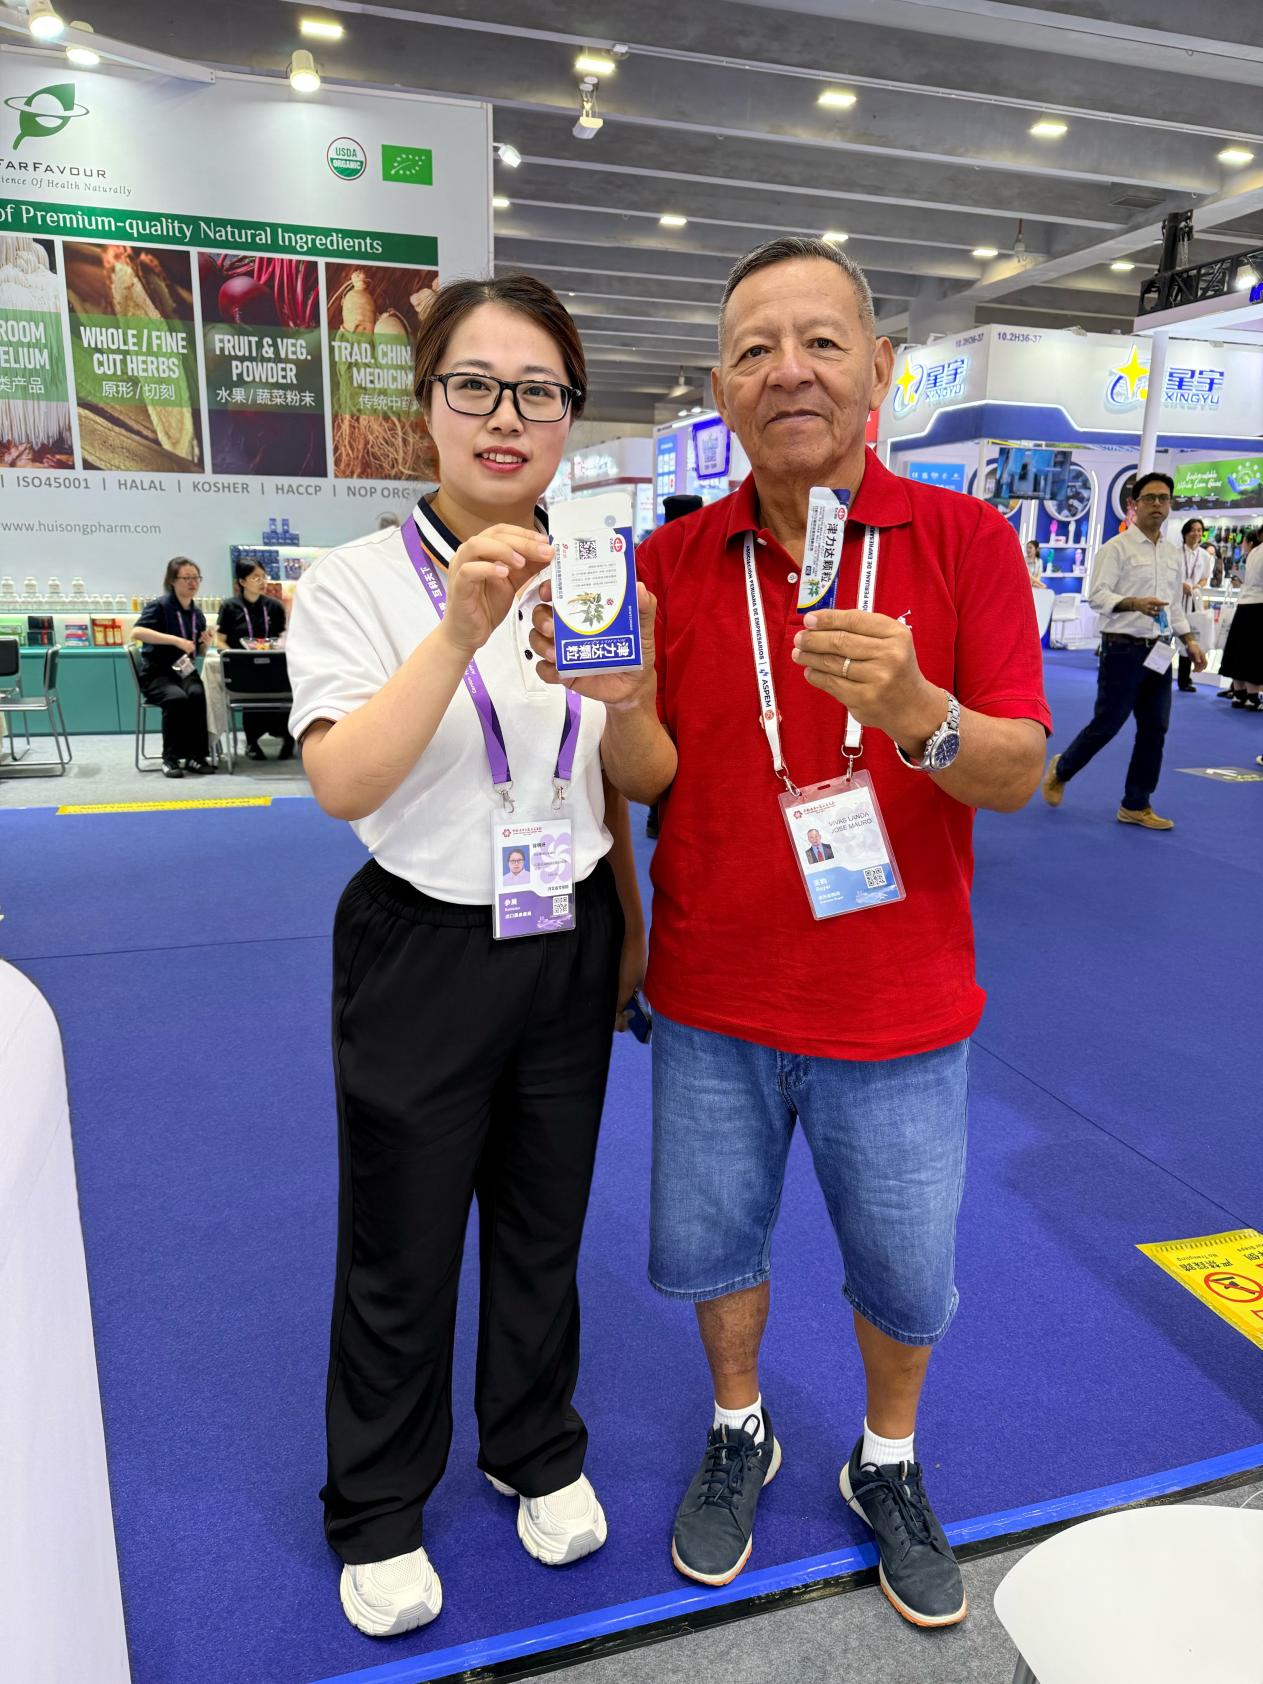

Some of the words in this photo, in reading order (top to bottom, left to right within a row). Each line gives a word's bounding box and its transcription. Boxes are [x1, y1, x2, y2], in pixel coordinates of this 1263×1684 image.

[335, 147, 358, 158] USDA
[31, 178, 42, 188] Of
[48, 180, 80, 190] Health
[84, 183, 132, 197] Naturally
[20, 205, 193, 242] Premium-quality
[199, 220, 271, 245] Natural
[278, 227, 383, 253] Ingredients
[80, 326, 138, 351] WHOLE
[152, 331, 188, 354] FINE
[214, 334, 258, 357] FRUIT
[261, 337, 275, 358] &
[276, 338, 312, 360] VEG.
[997, 332, 1042, 343] 10.2H36-37
[331, 341, 375, 363] TRAD.
[93, 353, 123, 375] CUT
[126, 355, 180, 378] HERBS
[231, 360, 297, 384] POWDER
[926, 358, 967, 388] 星宇
[352, 367, 415, 389] MEDICIN
[1165, 367, 1225, 392] 星宇
[216, 386, 247, 403] 水果
[256, 388, 316, 406] 蔬菜粉末
[925, 384, 965, 402] XINGYU
[1164, 392, 1219, 404] XINGYU
[16, 476, 91, 490] ISO45001
[118, 479, 166, 492] HALAL
[192, 481, 250, 494] KOSHER
[275, 483, 322, 496] HACCP
[347, 486, 377, 498] NOP
[381, 487, 416, 499] ORG
[1, 520, 162, 535] www.huisongpharm.com
[821, 523, 839, 583] 津力达颗粒
[866, 560, 873, 569] DE
[749, 580, 757, 607] PERUANA
[864, 571, 872, 598] PERUANA
[753, 608, 759, 617] DE
[755, 617, 765, 660] EMPRESARIOS
[565, 641, 630, 661] 津力达颗粒
[762, 679, 772, 707] ASPEM
[832, 825, 847, 833] JOSE
[849, 819, 873, 829] MAURO
[848, 811, 870, 822] LANDA
